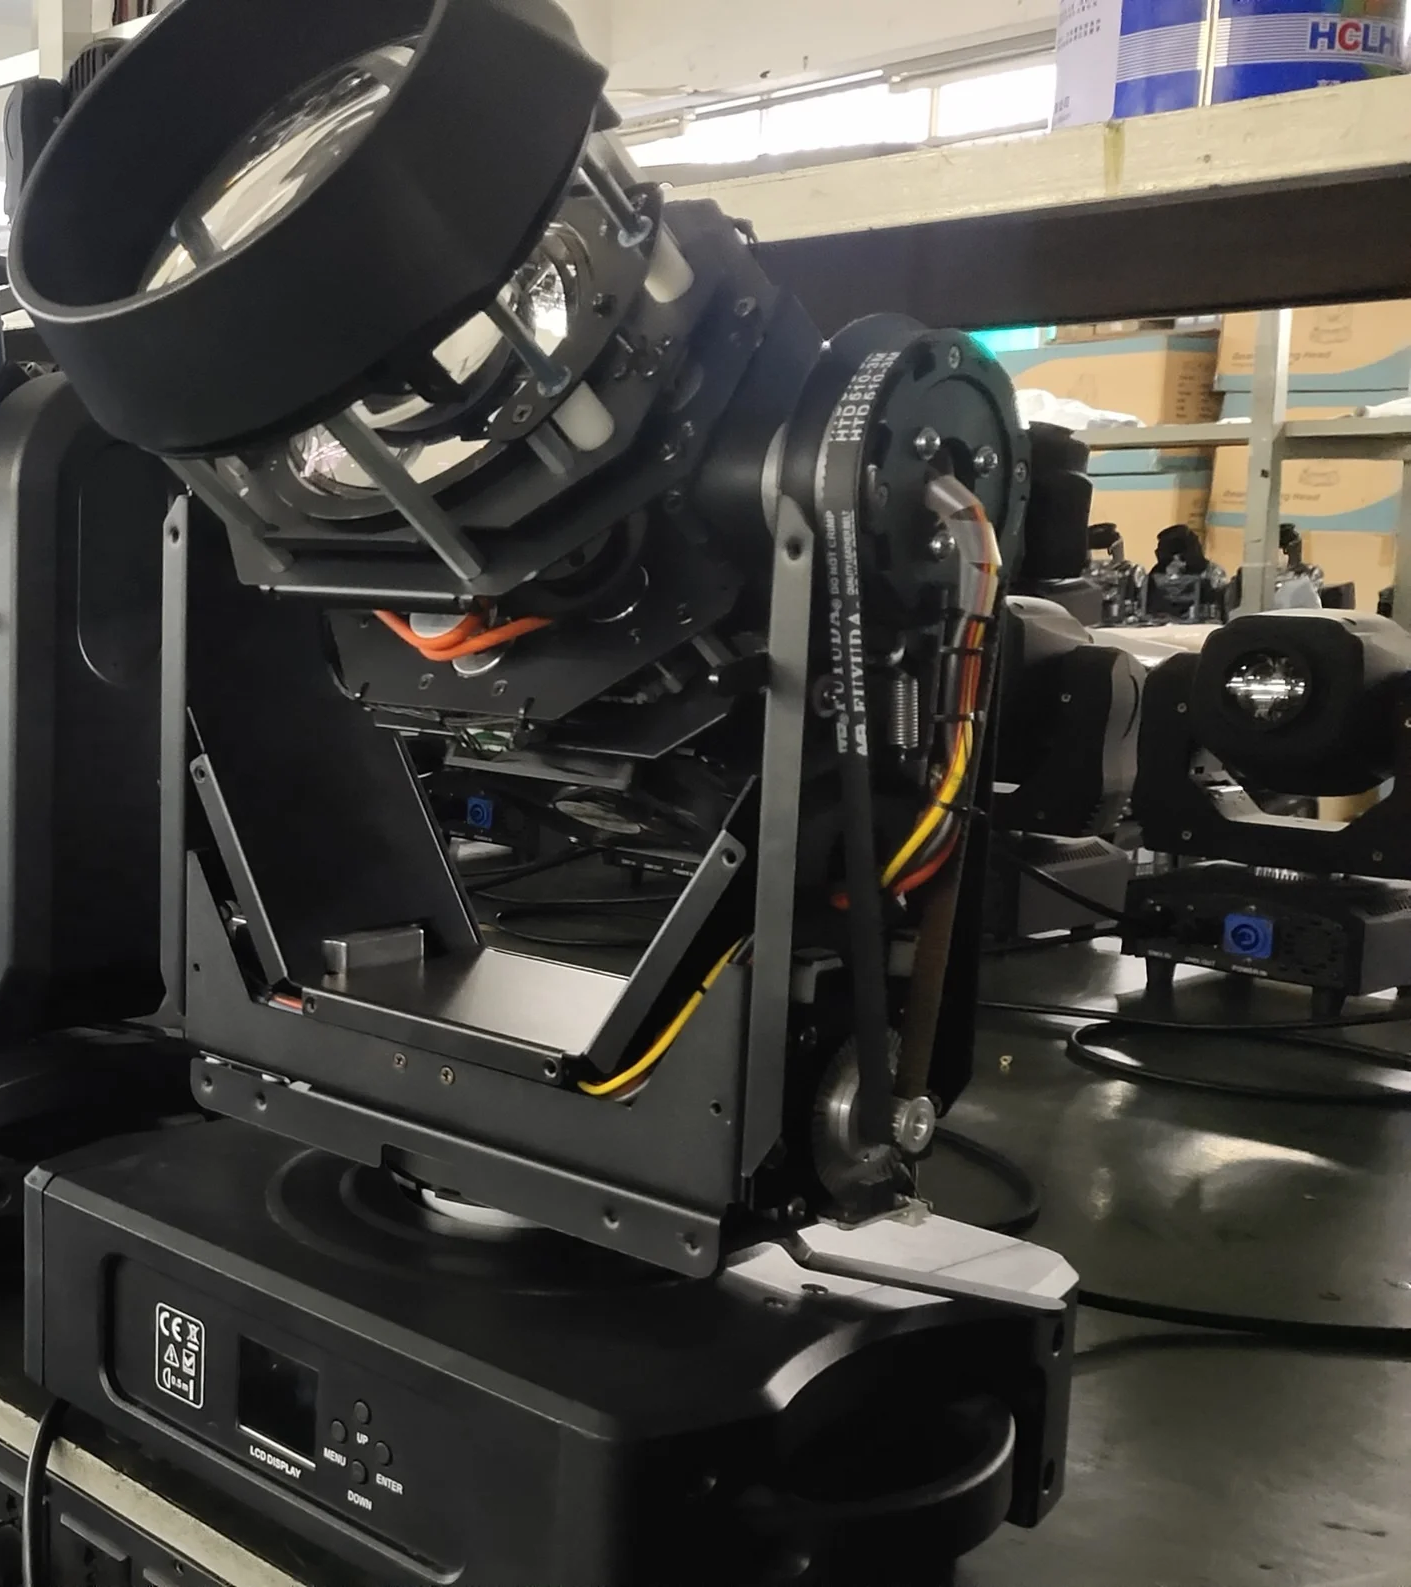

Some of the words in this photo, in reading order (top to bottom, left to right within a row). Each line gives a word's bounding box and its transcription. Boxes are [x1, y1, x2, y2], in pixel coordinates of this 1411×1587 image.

[835, 404, 857, 442] HTD
[850, 404, 870, 441] HTD
[825, 510, 837, 549] CRIMP
[356, 1431, 369, 1445] UP
[250, 1445, 267, 1461] LCD
[266, 1454, 302, 1479] DISPLAY
[323, 1447, 347, 1467] MENU
[375, 1472, 403, 1495] ENTER
[347, 1489, 372, 1511] DOWN
